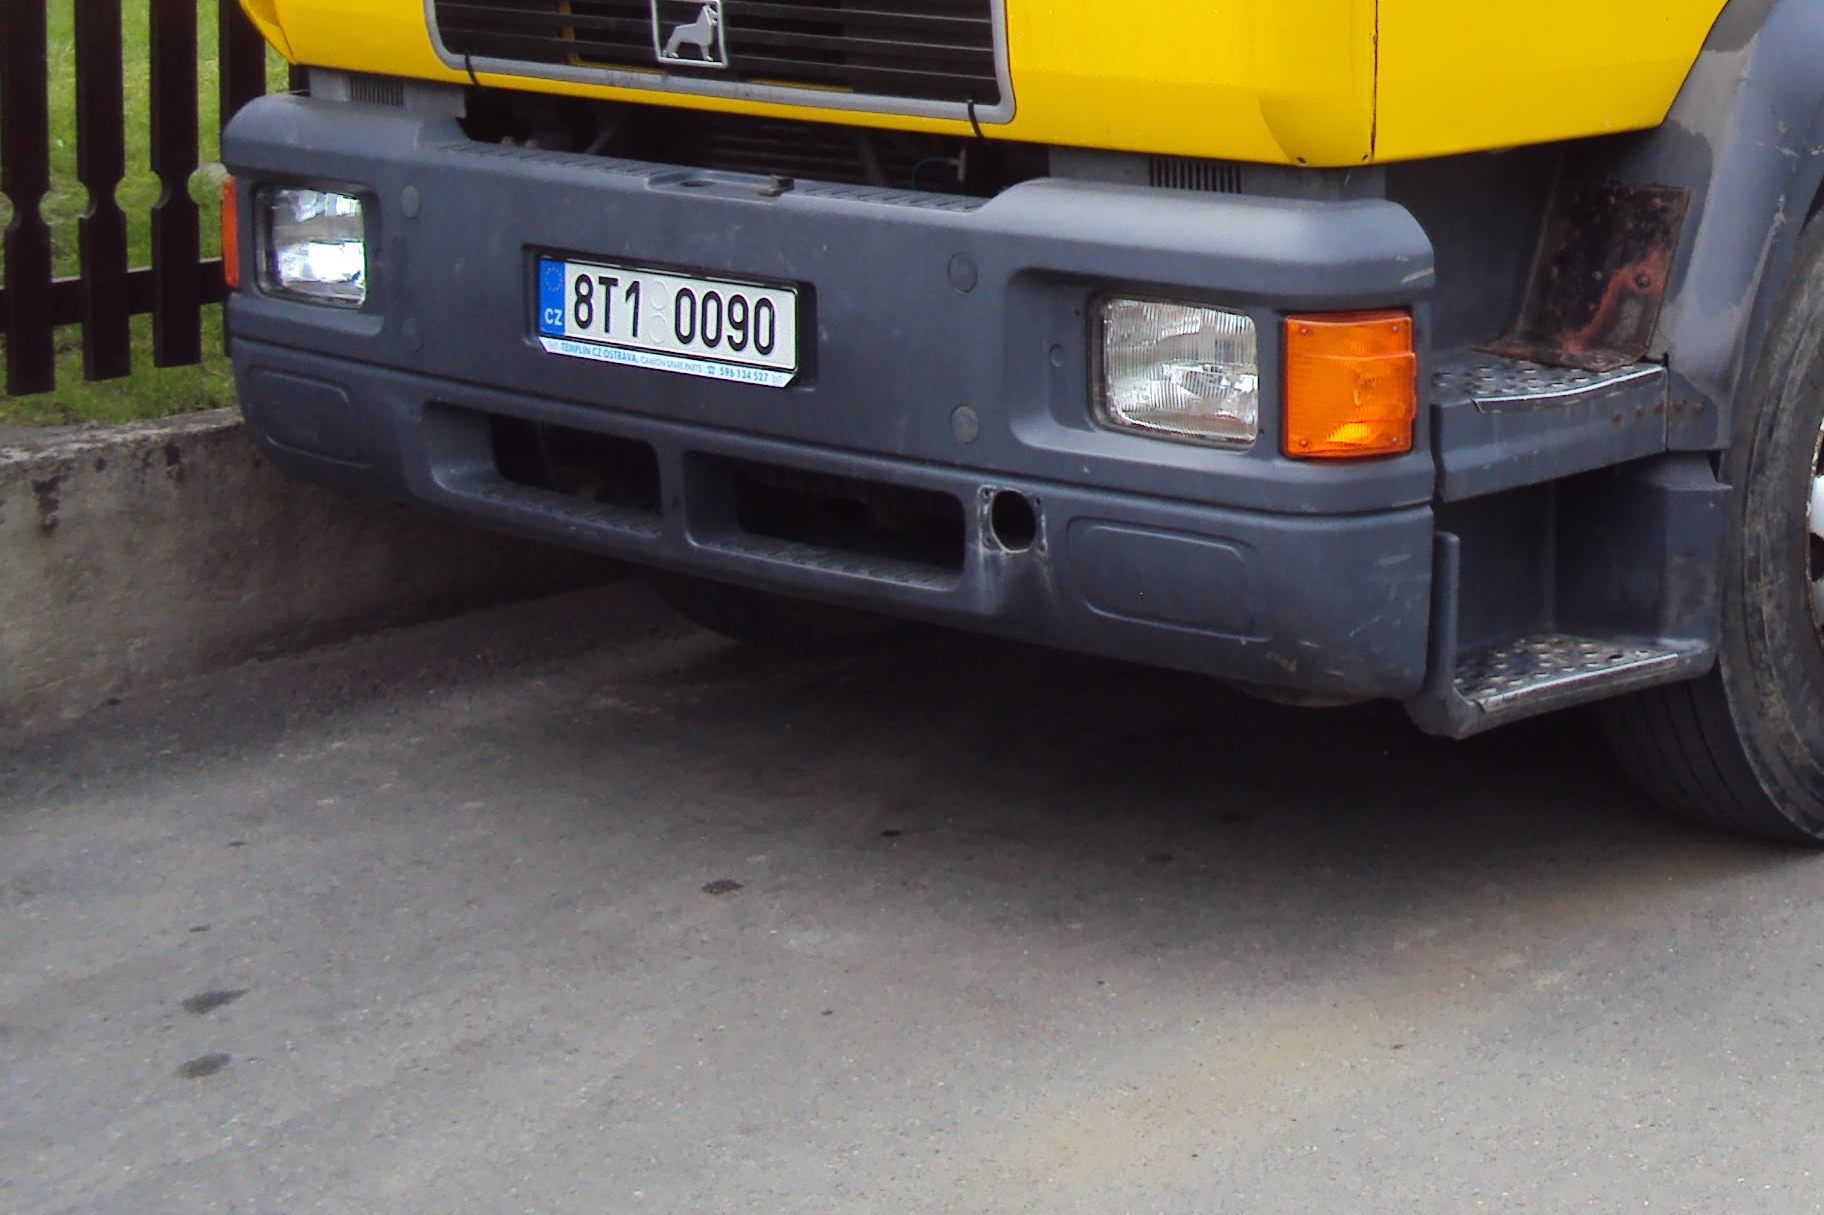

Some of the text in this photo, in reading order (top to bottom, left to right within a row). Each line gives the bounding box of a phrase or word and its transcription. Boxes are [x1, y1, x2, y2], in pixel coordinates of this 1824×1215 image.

[545, 307, 564, 325] CZ
[574, 273, 775, 355] 8T1 0090
[561, 342, 591, 355] TEMPLIN
[592, 347, 602, 358] CZ
